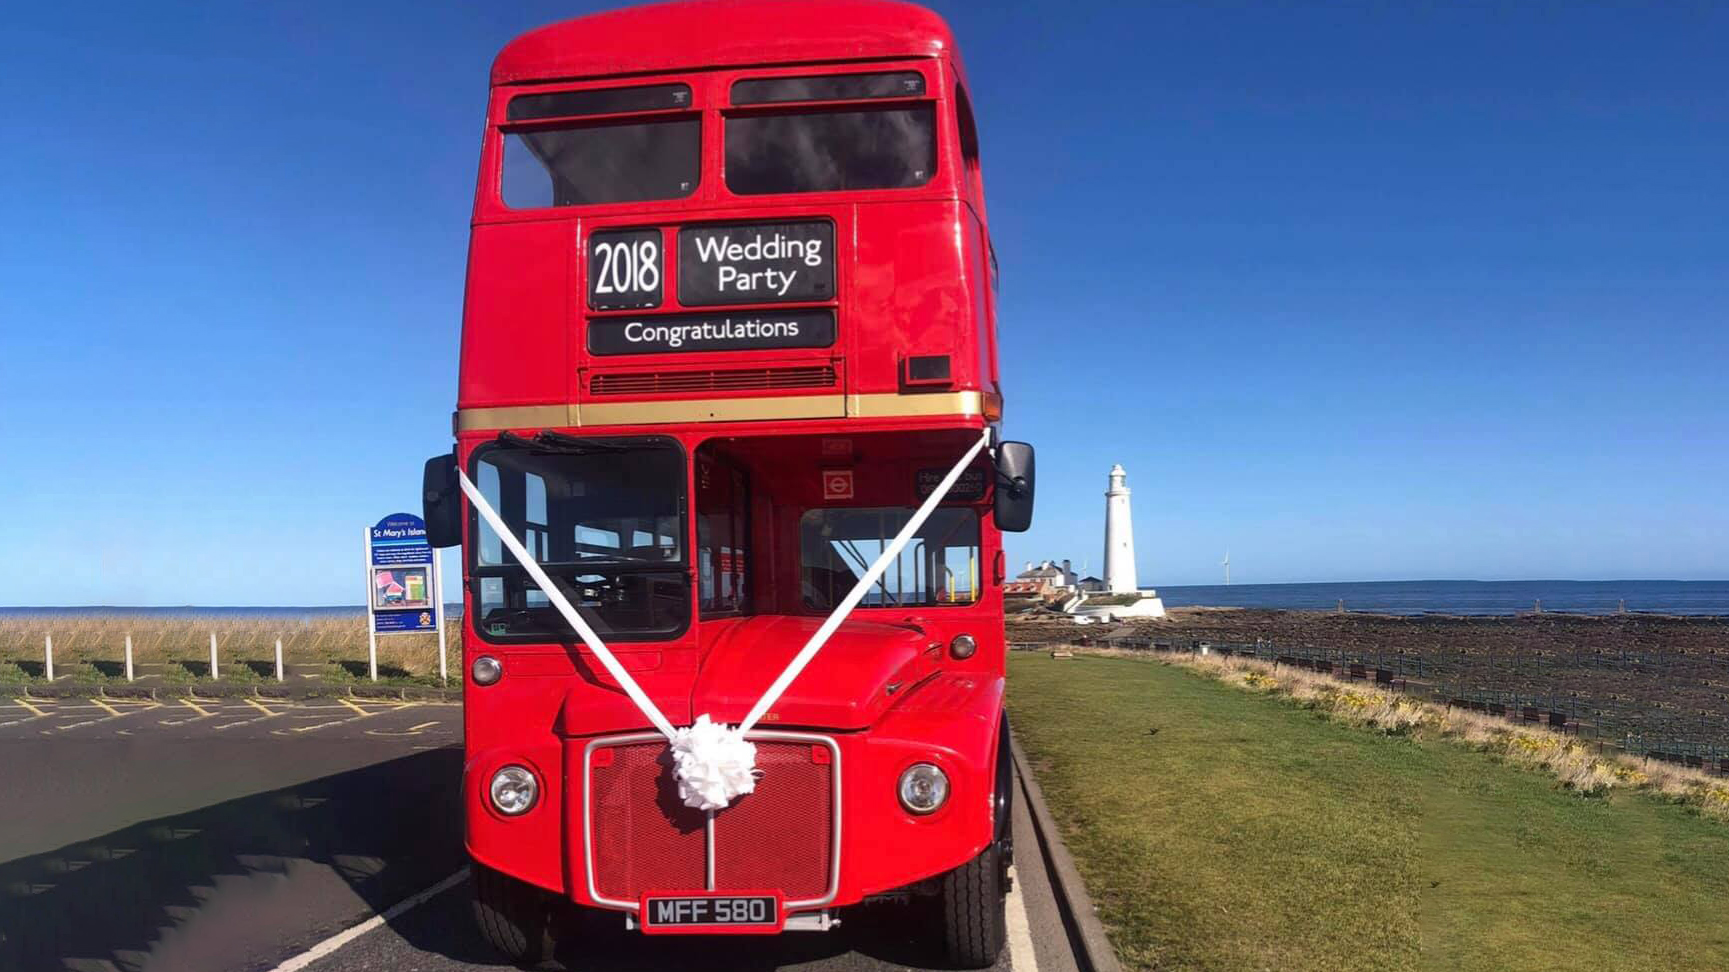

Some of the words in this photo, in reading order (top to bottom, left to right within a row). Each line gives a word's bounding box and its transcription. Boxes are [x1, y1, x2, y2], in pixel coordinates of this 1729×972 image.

[695, 233, 822, 266] Wedding
[595, 240, 660, 294] 2018
[718, 266, 797, 296] Party
[624, 319, 799, 347] Congratulations
[382, 528, 406, 538] Mary's
[407, 528, 427, 536] Islan
[657, 900, 708, 923] MFF
[715, 899, 766, 922] 580
